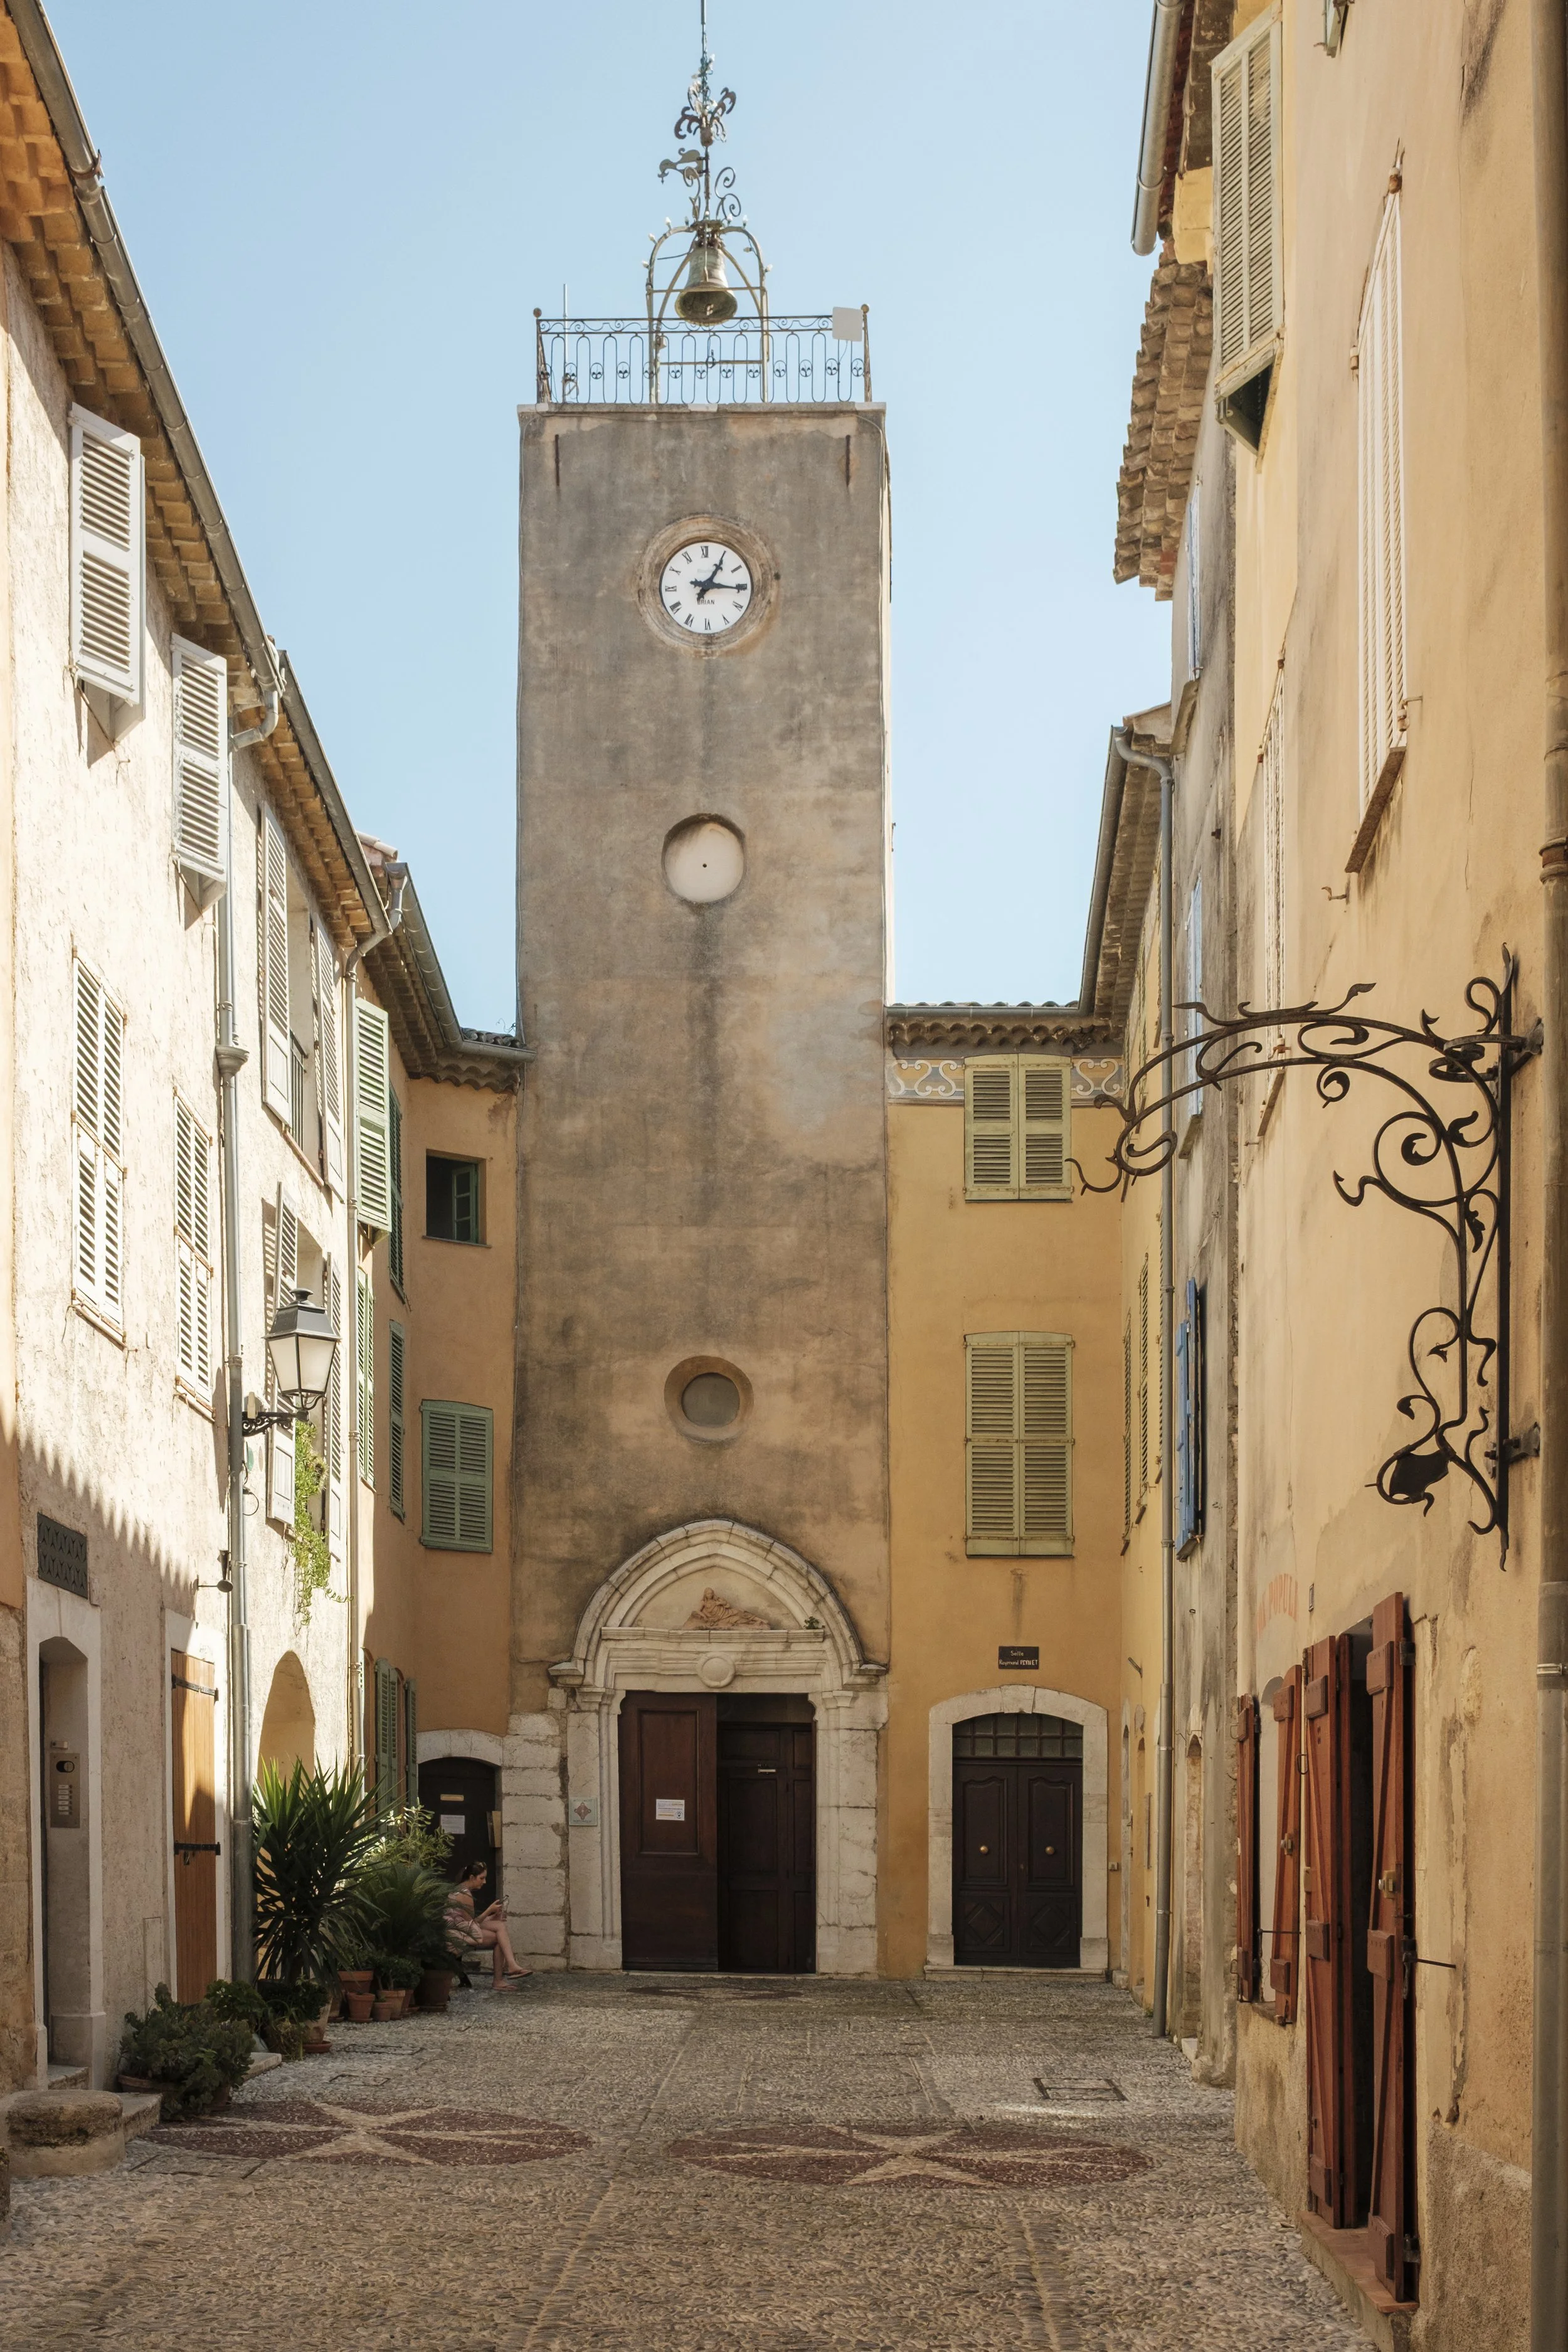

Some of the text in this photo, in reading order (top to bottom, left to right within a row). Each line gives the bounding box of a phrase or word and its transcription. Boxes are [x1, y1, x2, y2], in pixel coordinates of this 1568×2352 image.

[682, 551, 692, 564] XI
[701, 546, 709, 558] XII
[669, 566, 681, 575] X
[669, 601, 682, 615] VIII
[684, 613, 694, 627] VII
[704, 618, 711, 630] VI
[722, 614, 729, 625] V
